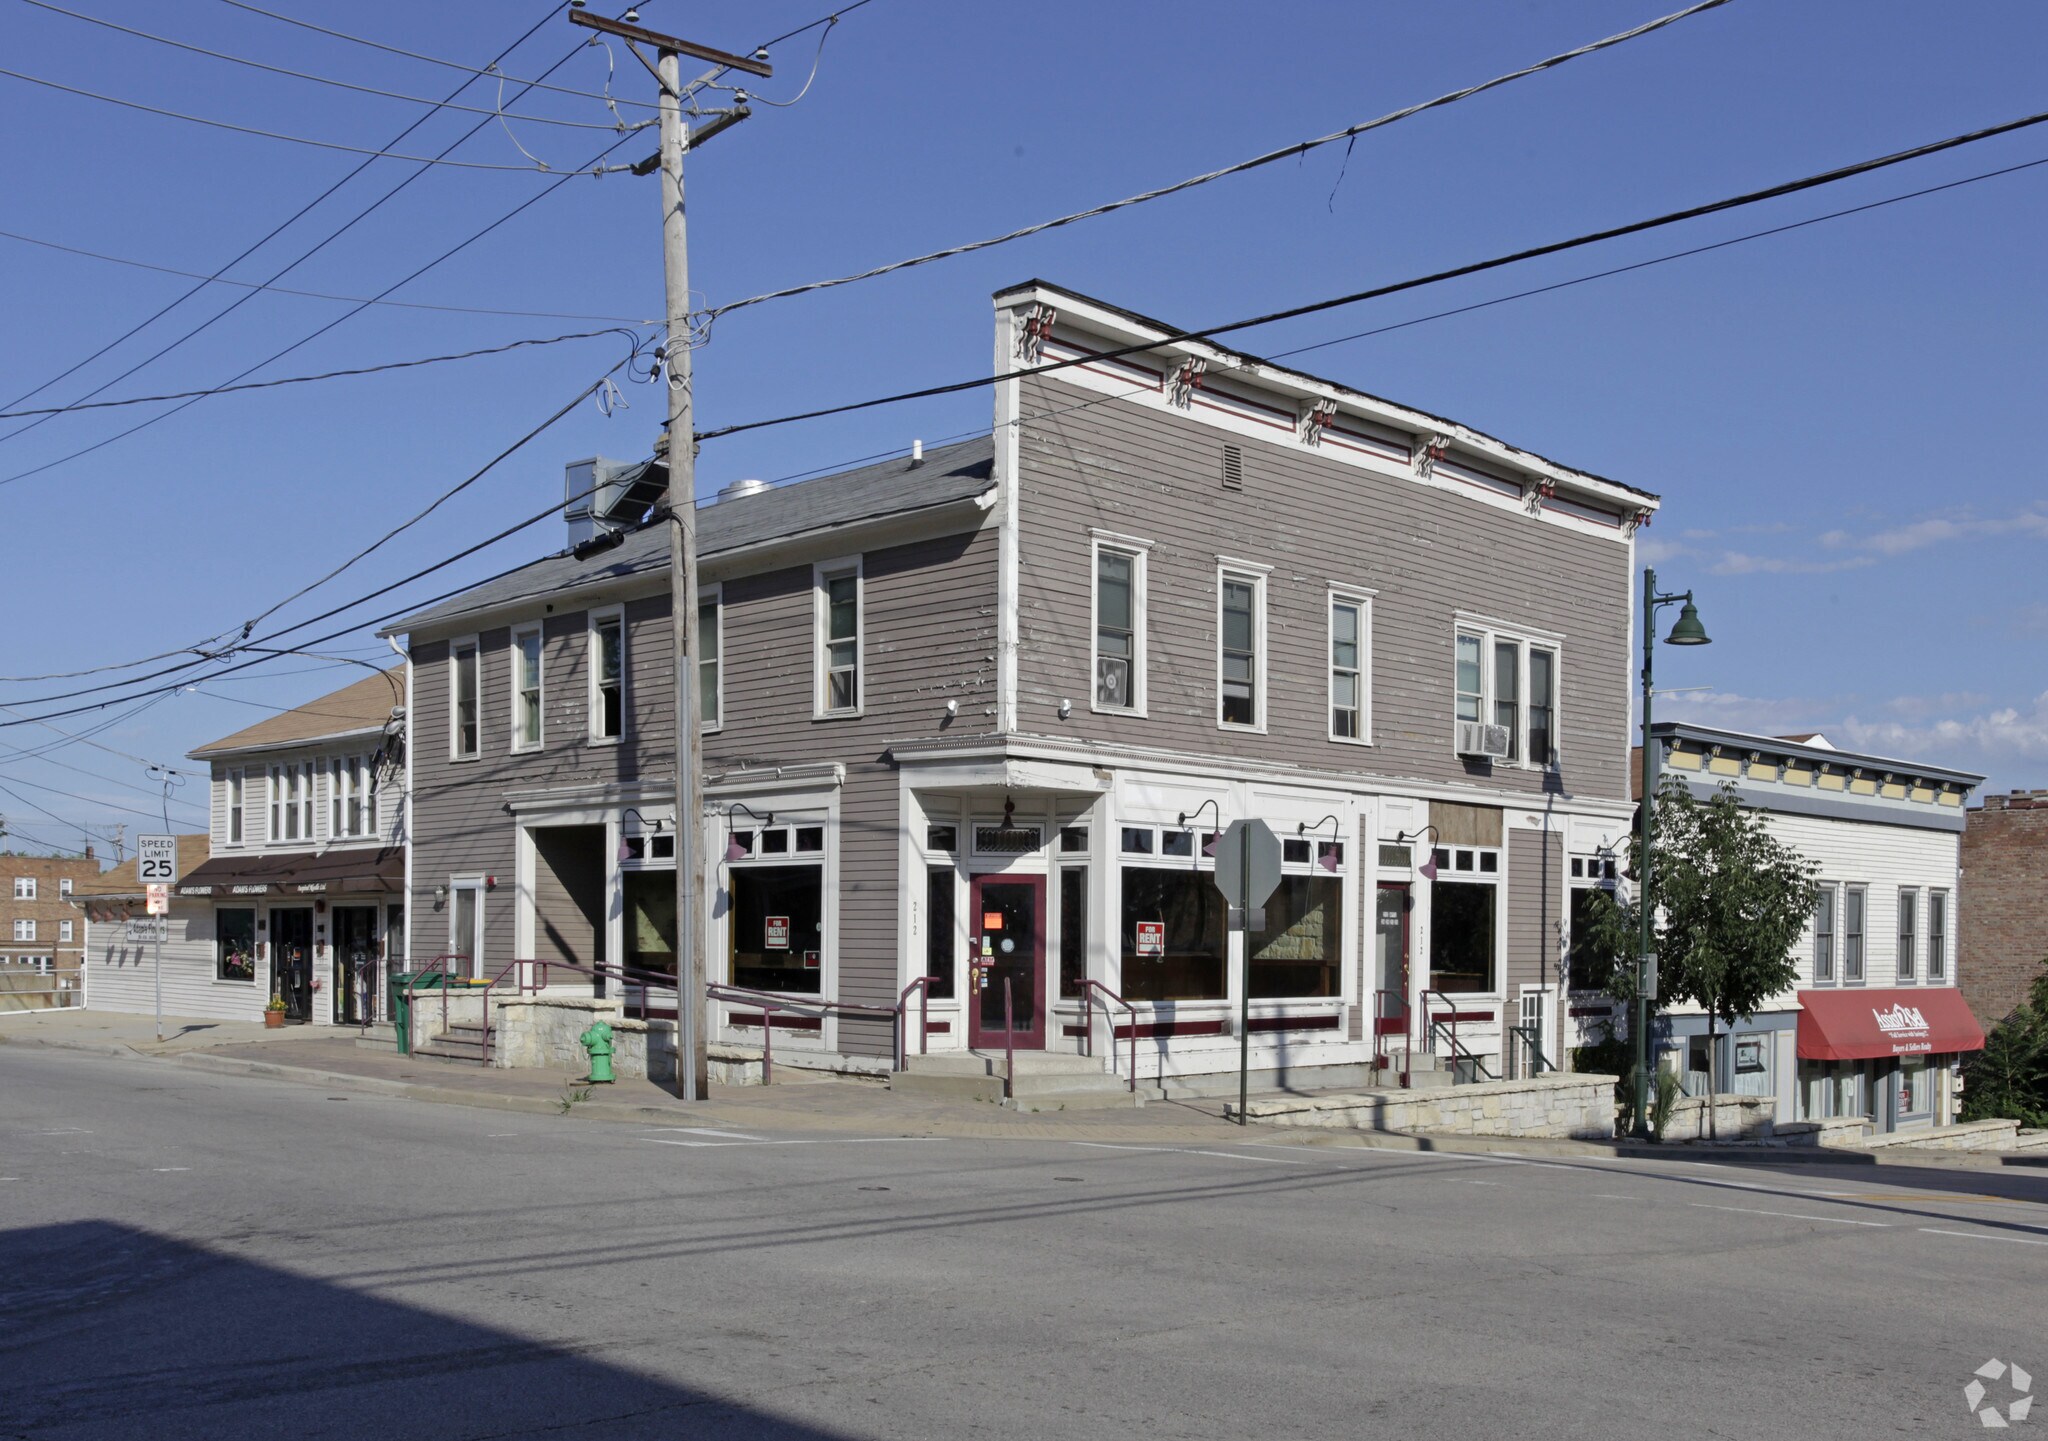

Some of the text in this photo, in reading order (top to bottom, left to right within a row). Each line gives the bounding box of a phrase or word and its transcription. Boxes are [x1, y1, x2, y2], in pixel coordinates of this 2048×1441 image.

[141, 840, 173, 848] SPEED
[145, 850, 170, 858] LIMIT
[142, 860, 172, 877] 25
[248, 884, 268, 893] FLOWERS
[768, 926, 787, 937] RENT
[1139, 932, 1161, 944] RENT
